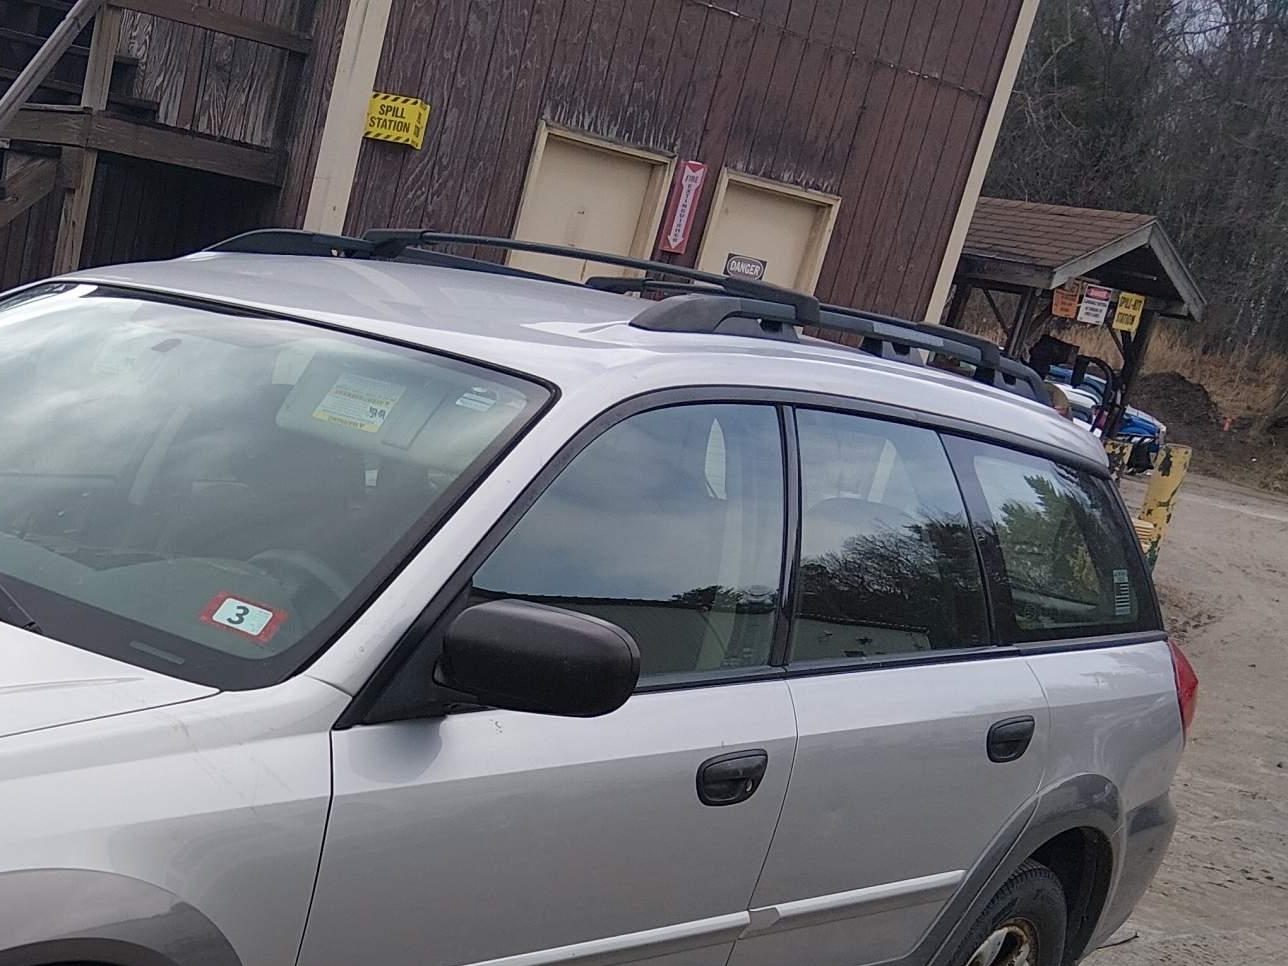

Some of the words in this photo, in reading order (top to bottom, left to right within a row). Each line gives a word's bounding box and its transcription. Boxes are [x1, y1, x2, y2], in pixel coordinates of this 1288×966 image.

[378, 104, 406, 119] SPILL
[369, 116, 411, 133] STATION
[730, 260, 761, 276] DANGER
[226, 605, 250, 625] 3
